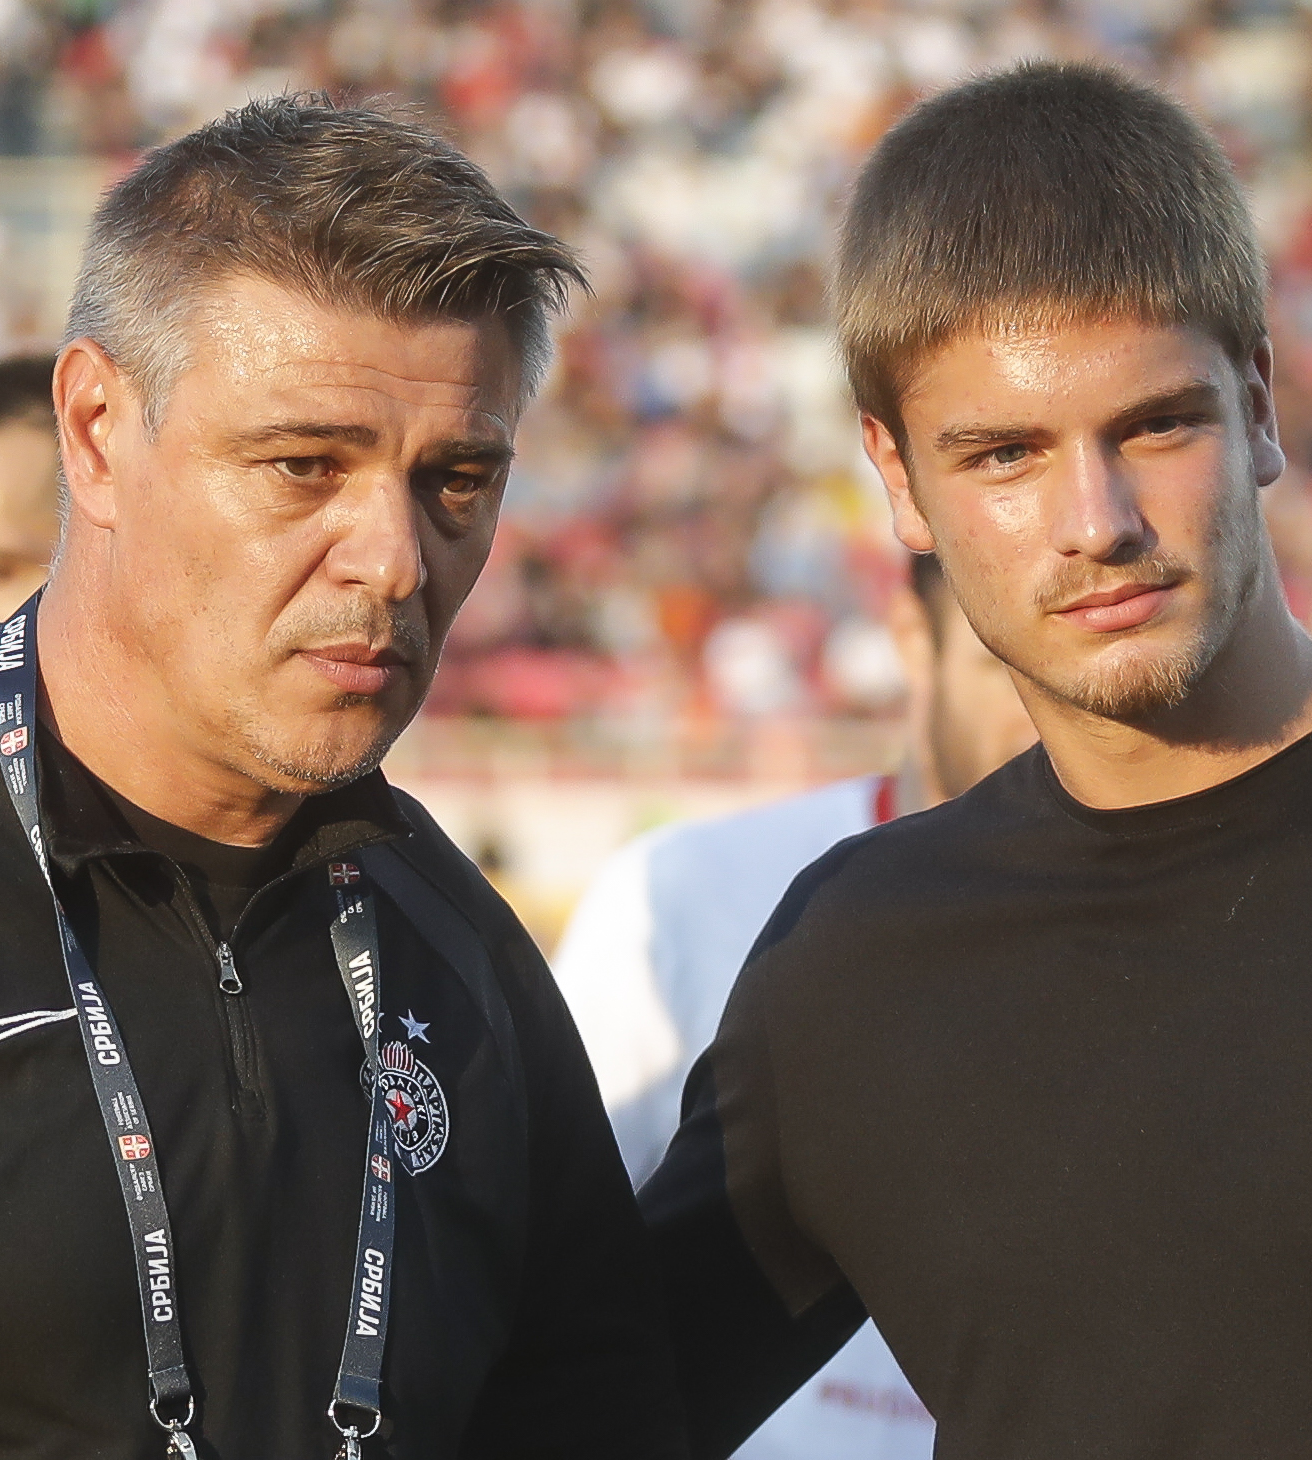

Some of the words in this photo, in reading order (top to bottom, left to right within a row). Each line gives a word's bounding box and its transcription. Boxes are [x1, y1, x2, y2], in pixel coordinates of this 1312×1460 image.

[78, 981, 121, 1066] СРБИЈА
[348, 950, 375, 1039] СРБИЈА
[144, 1228, 174, 1323] СРБИЈА
[355, 1248, 385, 1336] СРБИЈА
